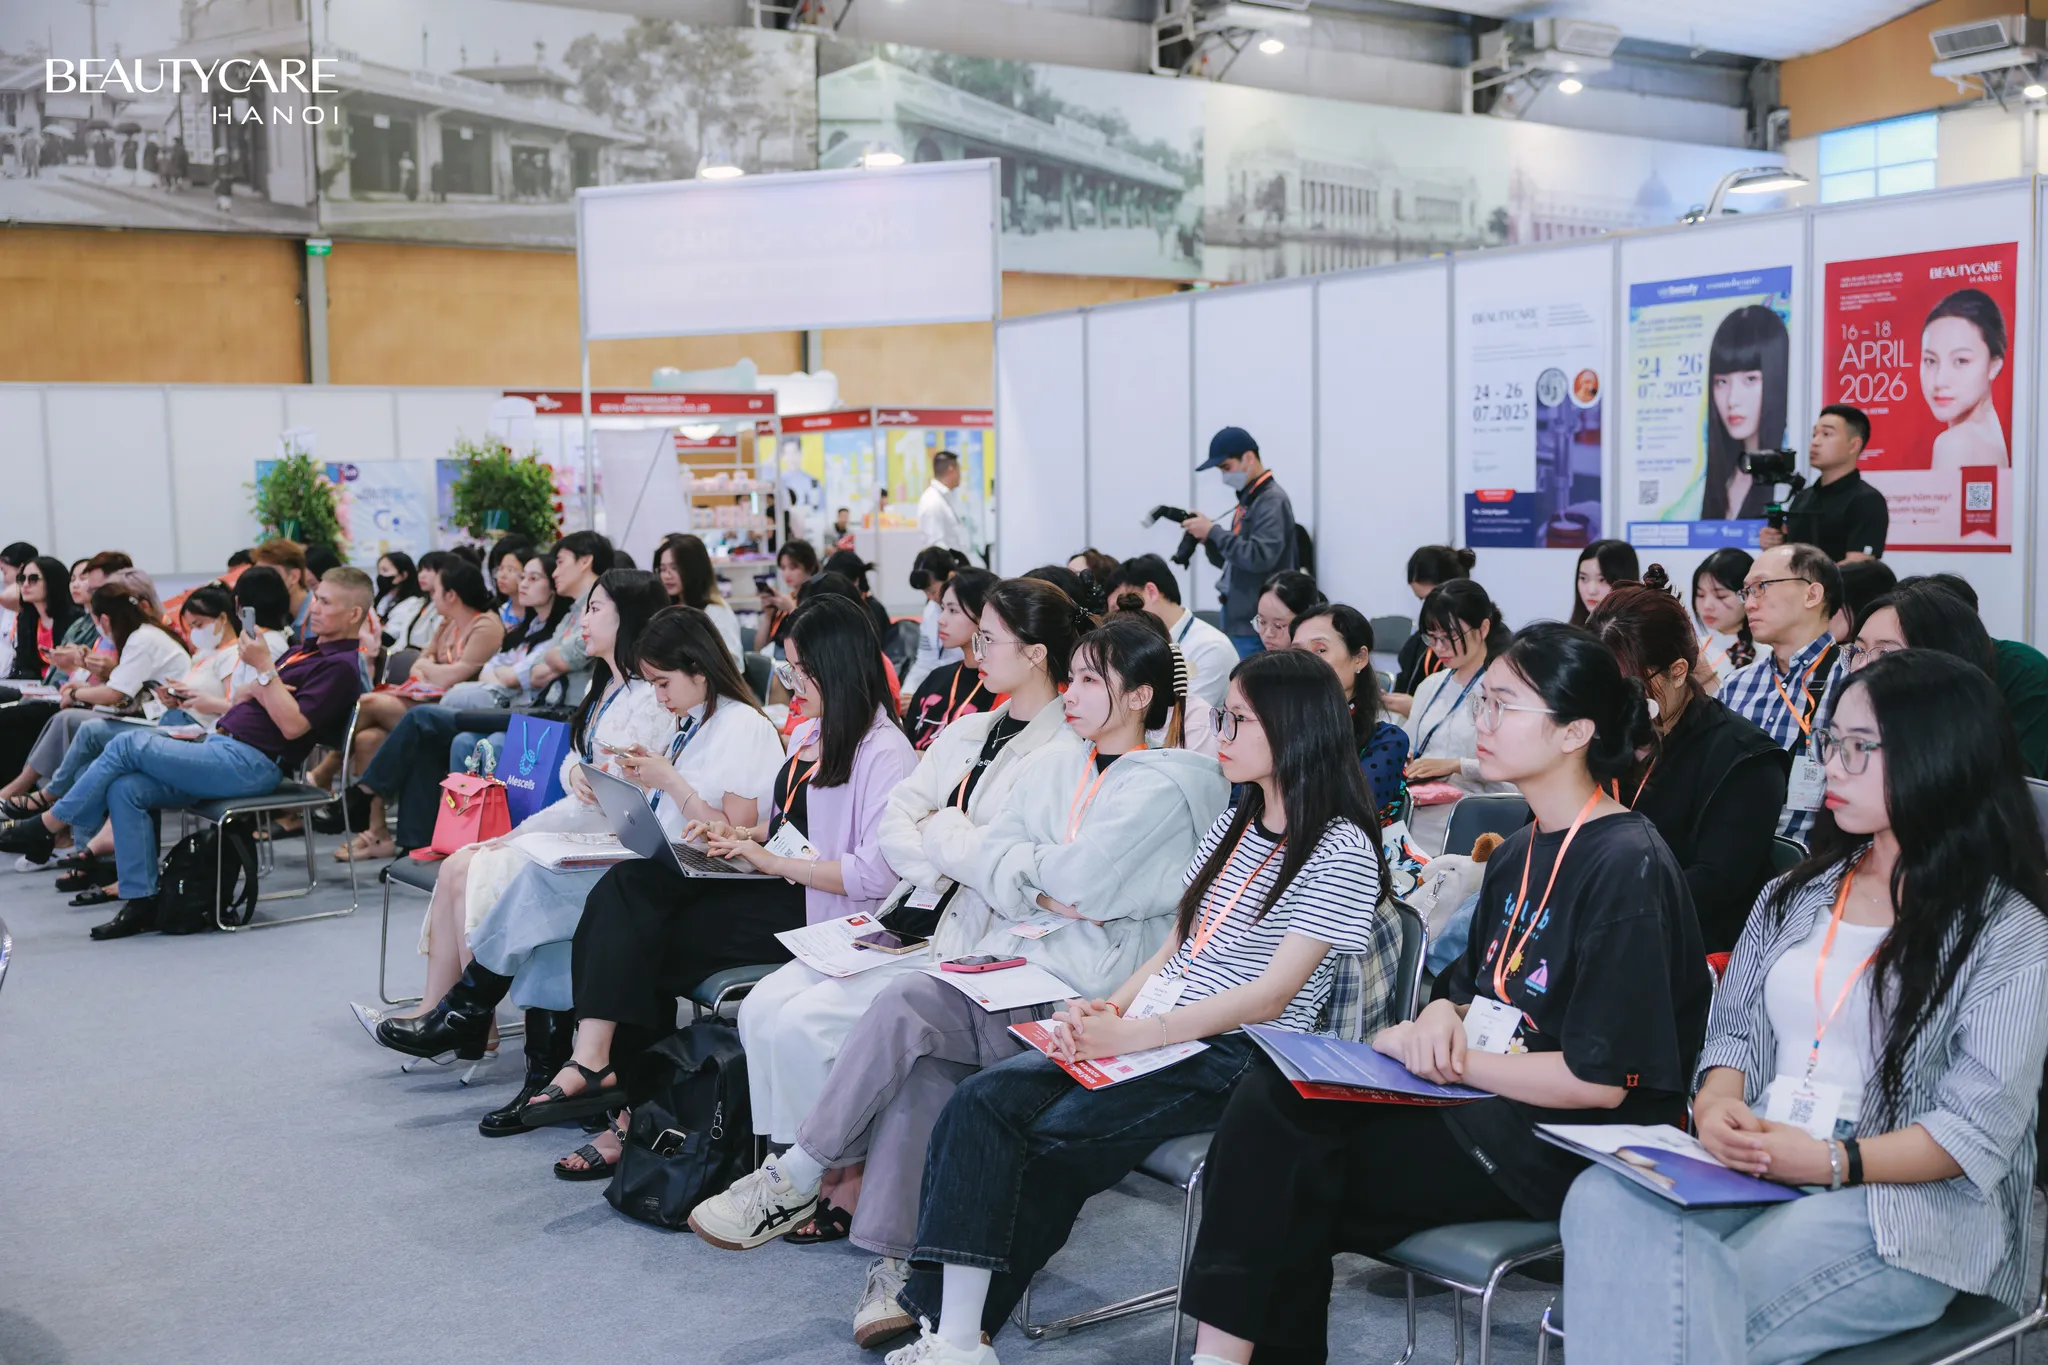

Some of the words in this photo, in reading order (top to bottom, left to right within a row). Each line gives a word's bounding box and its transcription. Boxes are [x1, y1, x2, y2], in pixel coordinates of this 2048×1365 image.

[1929, 260, 2002, 280] BEAUTYCARE
[1968, 274, 2003, 284] HANOI
[1841, 323, 1859, 341] 16
[1874, 320, 1892, 338] 18
[1839, 340, 1913, 371] APRIL
[1638, 357, 1661, 379] 24
[1678, 353, 1704, 376] 26
[1473, 384, 1490, 401] 24
[1505, 382, 1523, 399] 26
[1839, 373, 1908, 404] 2026
[1473, 404, 1529, 423] 07.2025
[506, 774, 534, 790] Mescells
[770, 1170, 782, 1184] asics
